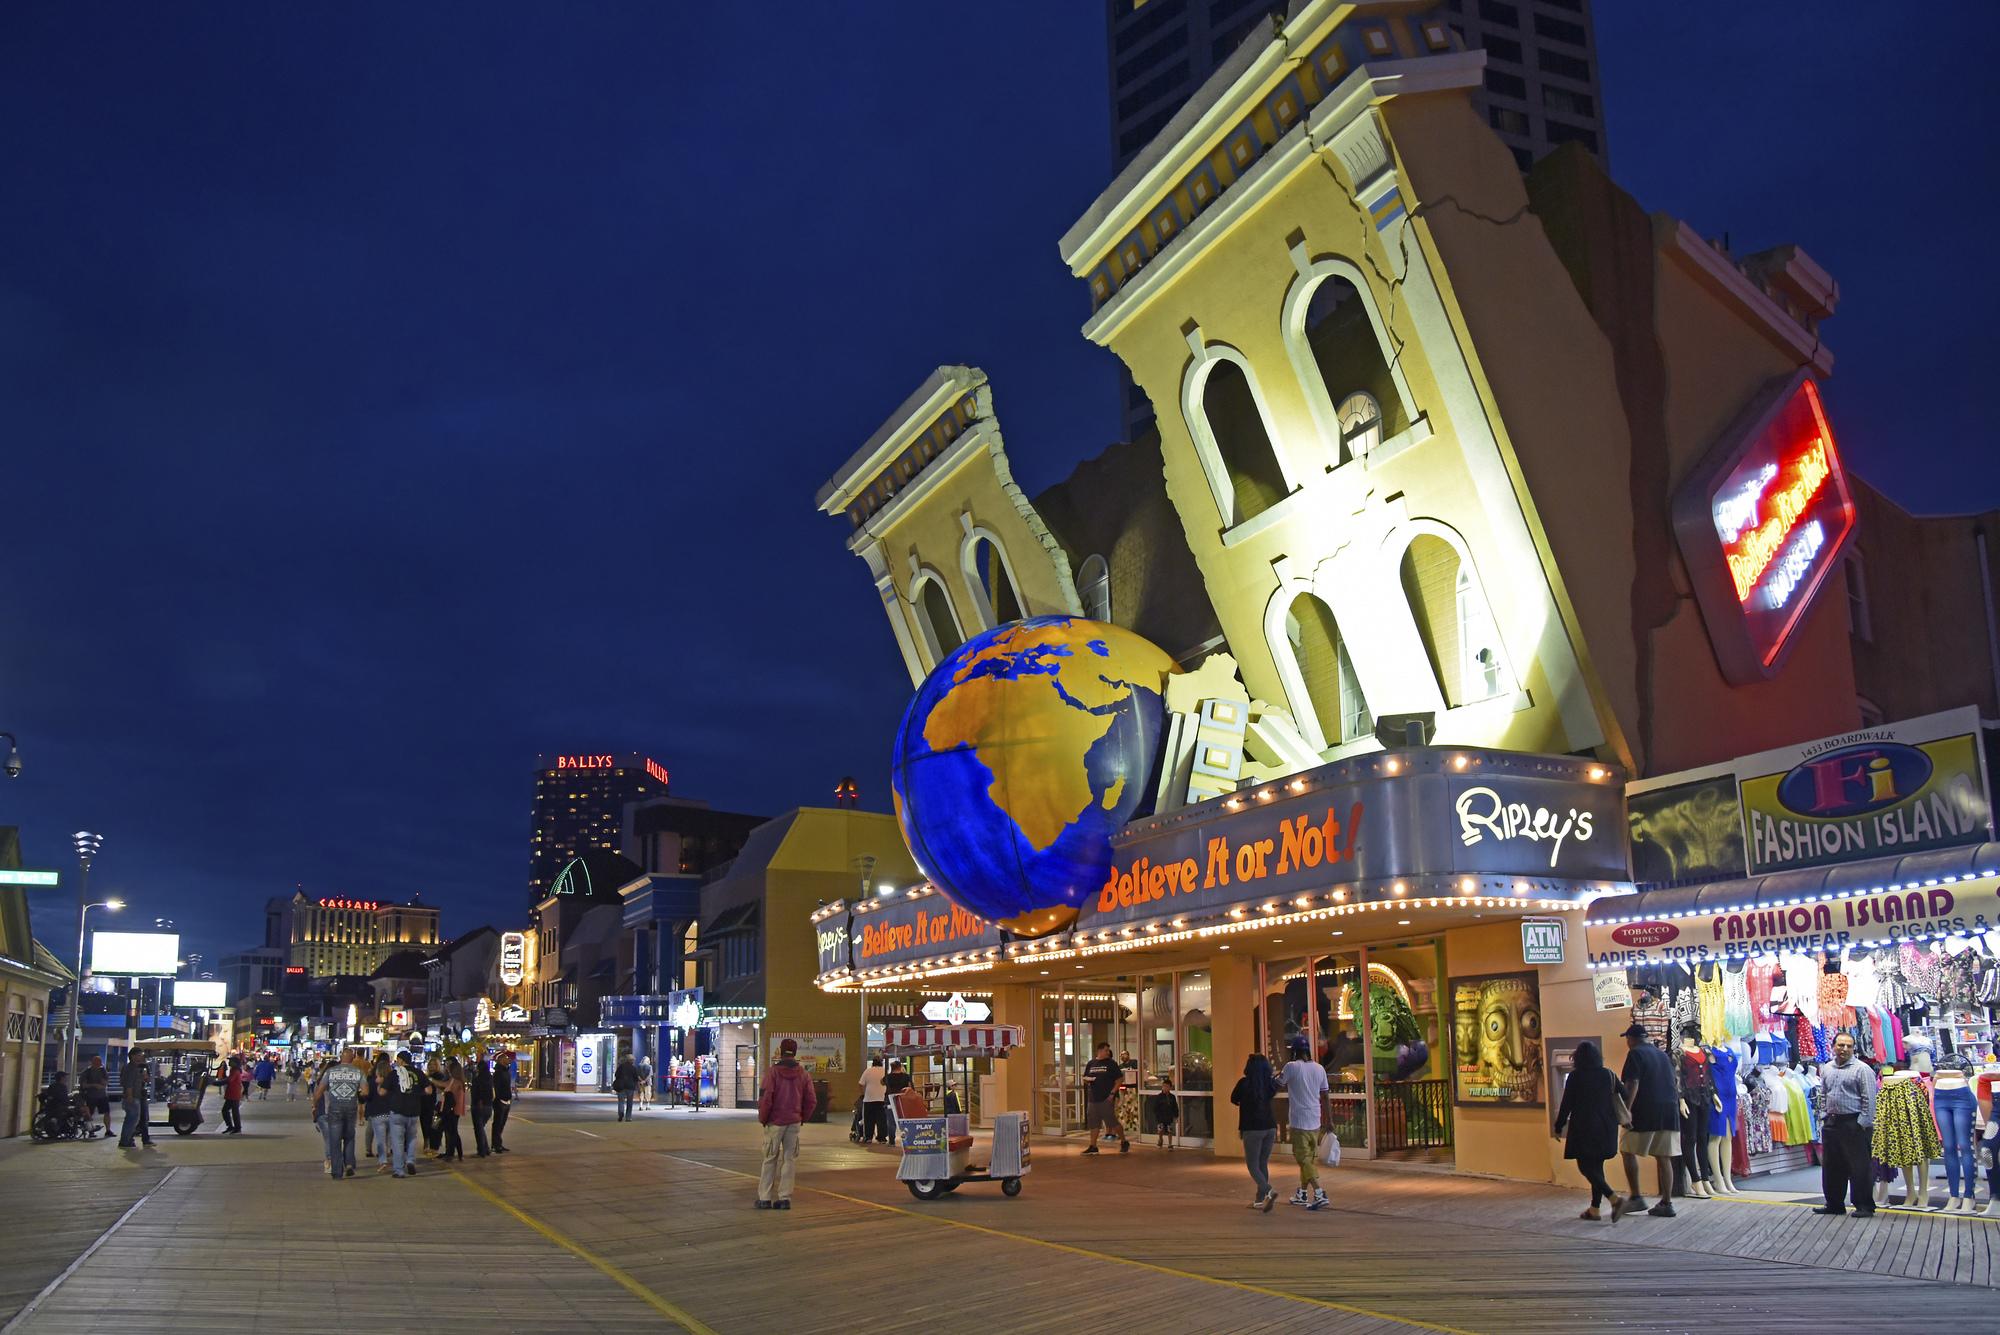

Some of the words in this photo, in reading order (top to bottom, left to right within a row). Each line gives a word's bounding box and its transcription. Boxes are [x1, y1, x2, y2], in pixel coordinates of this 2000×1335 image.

[1801, 743, 1823, 759] 1433
[1824, 731, 1896, 749] BOARDWALK
[1801, 750, 1901, 812] Fi
[1751, 809, 1866, 864] FASHION
[1874, 773, 1976, 847] ISLAND
[1097, 856, 1199, 913] Believe
[1203, 835, 1230, 889] It
[1235, 838, 1274, 883] or
[1276, 801, 1364, 876] Not!
[319, 899, 378, 911] CAESARS
[1713, 904, 1832, 942] FASHION
[1845, 889, 1955, 927] ISLAND
[862, 920, 913, 958] Believe
[914, 911, 928, 946] It
[929, 914, 949, 943] or
[1526, 927, 1560, 947] ATM
[1588, 950, 1648, 965] LADIES
[1662, 944, 1709, 960] TOPS
[1725, 931, 1850, 956] BEACHWEAR
[1888, 917, 1966, 939] CIGARS
[1622, 926, 1670, 936] TOBACCO
[1632, 936, 1660, 944] PIPES
